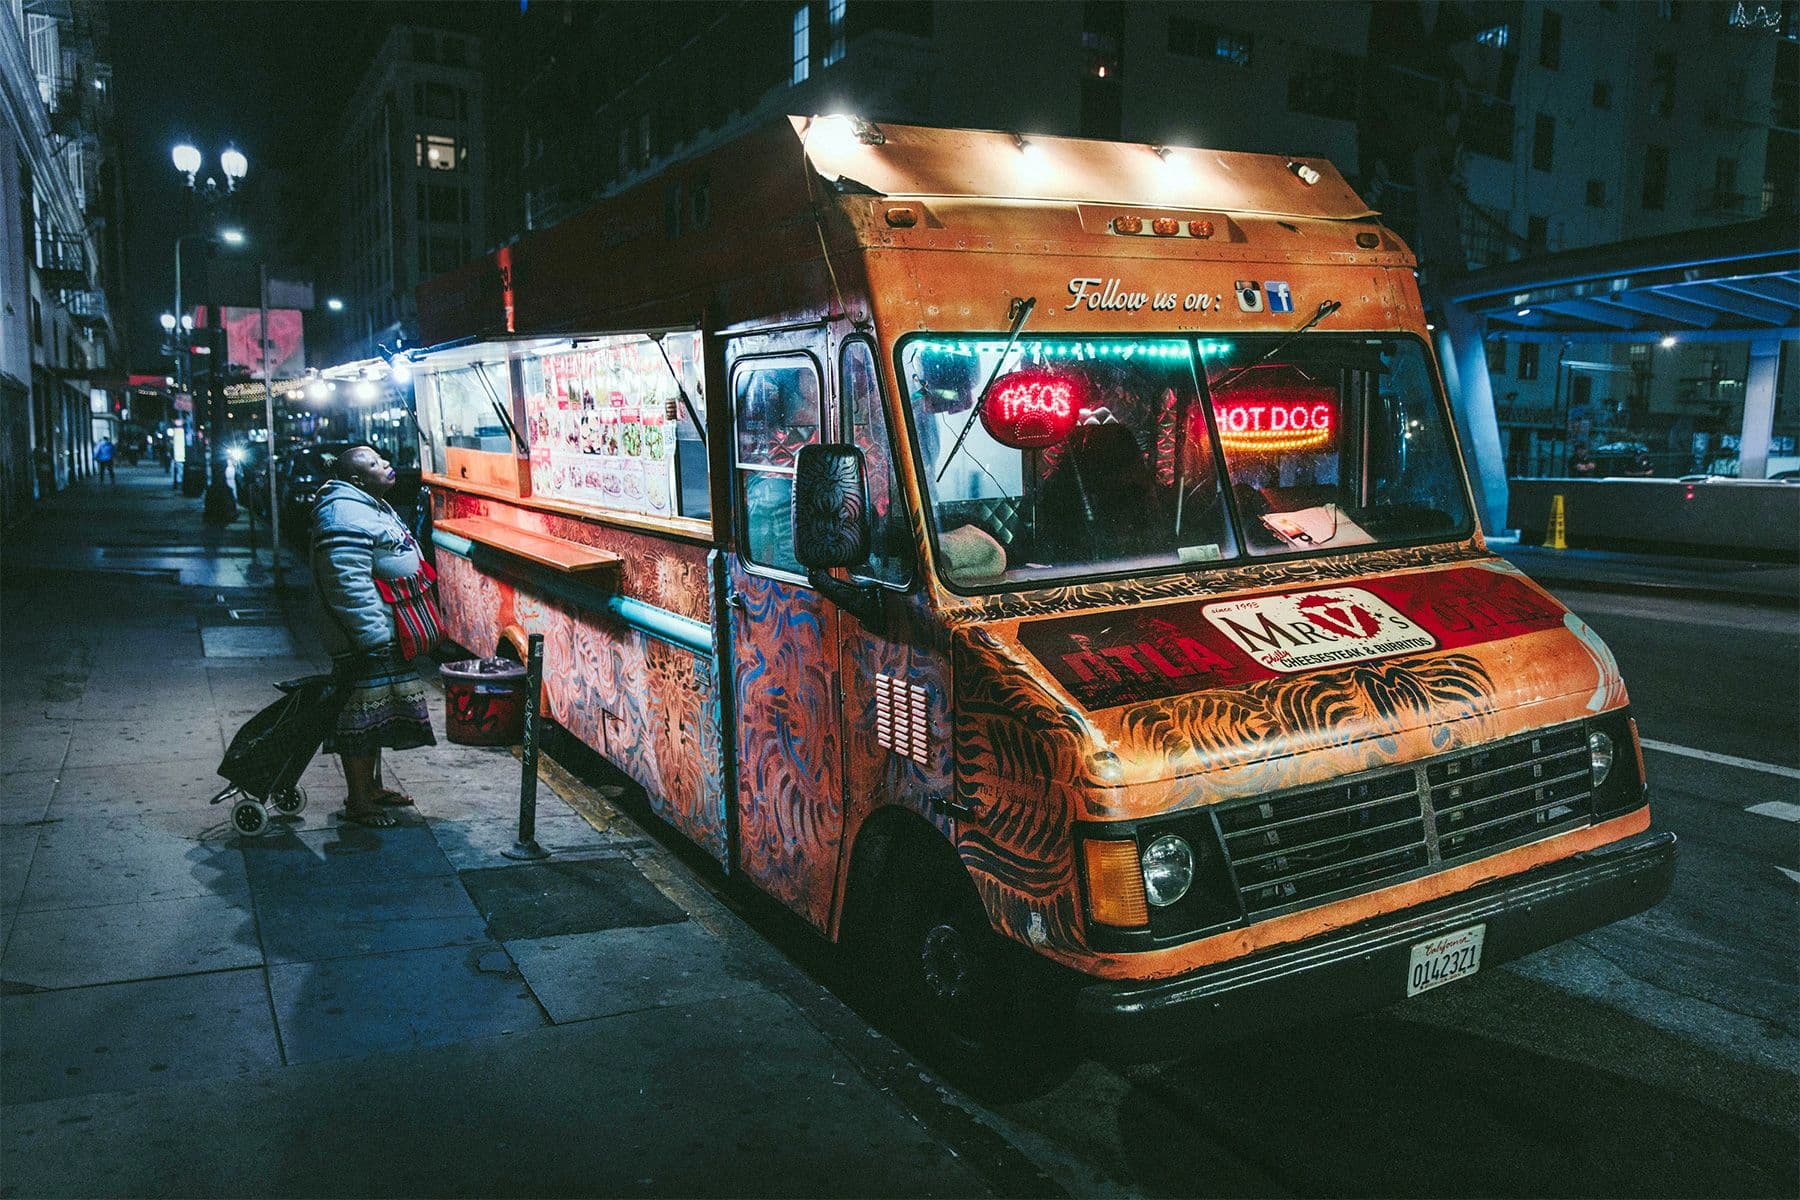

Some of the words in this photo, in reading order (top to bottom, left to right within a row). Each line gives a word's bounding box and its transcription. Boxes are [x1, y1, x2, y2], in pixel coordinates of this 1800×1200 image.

[1064, 277, 1149, 311] Follow
[1151, 292, 1178, 311] us
[998, 382, 1071, 420] TACOS
[1215, 406, 1266, 431] HOT
[1270, 405, 1329, 430] DOG
[1260, 648, 1293, 667] Philly
[1280, 648, 1362, 669] CHEESESTEAK
[1365, 645, 1376, 656] &
[1375, 637, 1431, 654] BURRITOS
[1425, 937, 1469, 956] California
